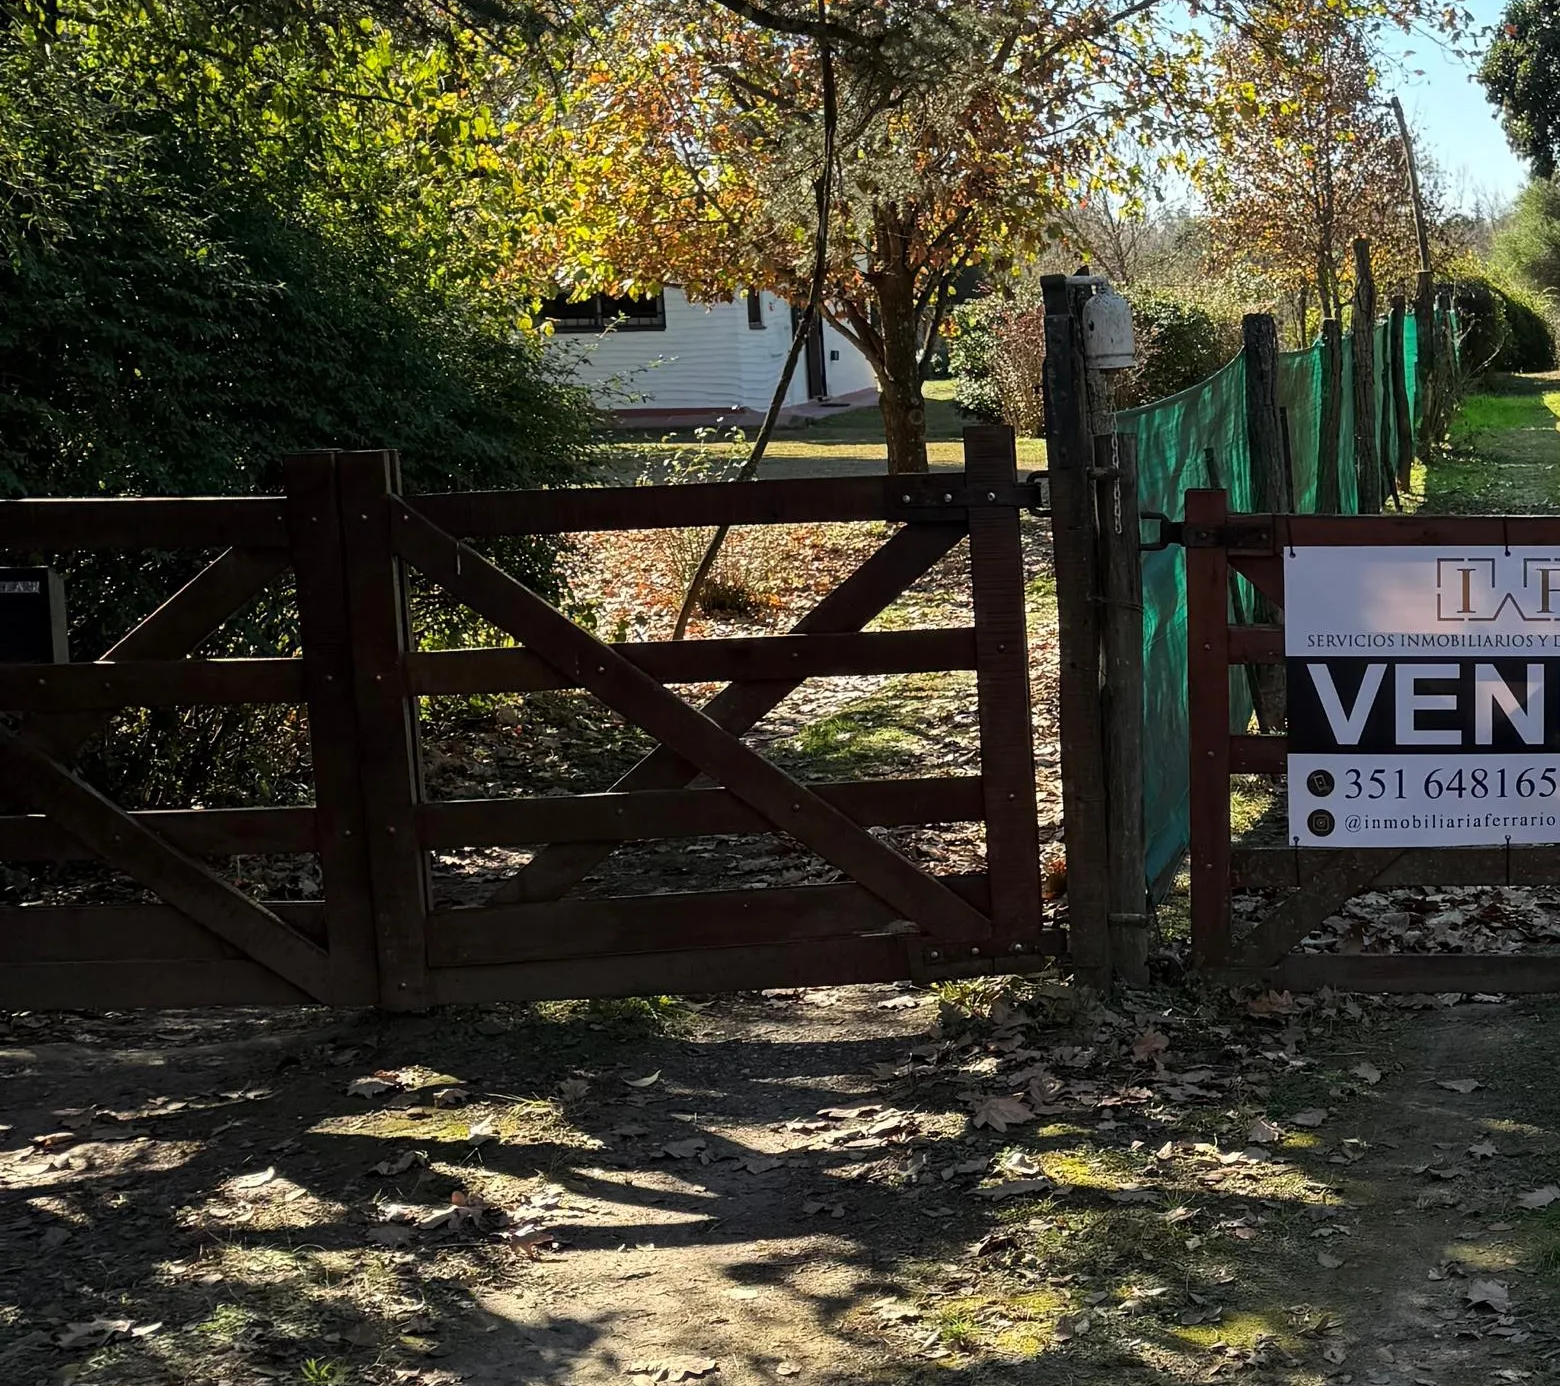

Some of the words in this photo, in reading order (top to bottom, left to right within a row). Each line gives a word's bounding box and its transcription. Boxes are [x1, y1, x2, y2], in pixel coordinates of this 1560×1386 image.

[1307, 633, 1395, 648] SERVICIOS
[1400, 633, 1534, 648] INMOBILIARIOS
[1537, 633, 1549, 648] Y
[1344, 768, 1407, 800] 351
[1344, 812, 1557, 833] @inmobiliariaferrario
